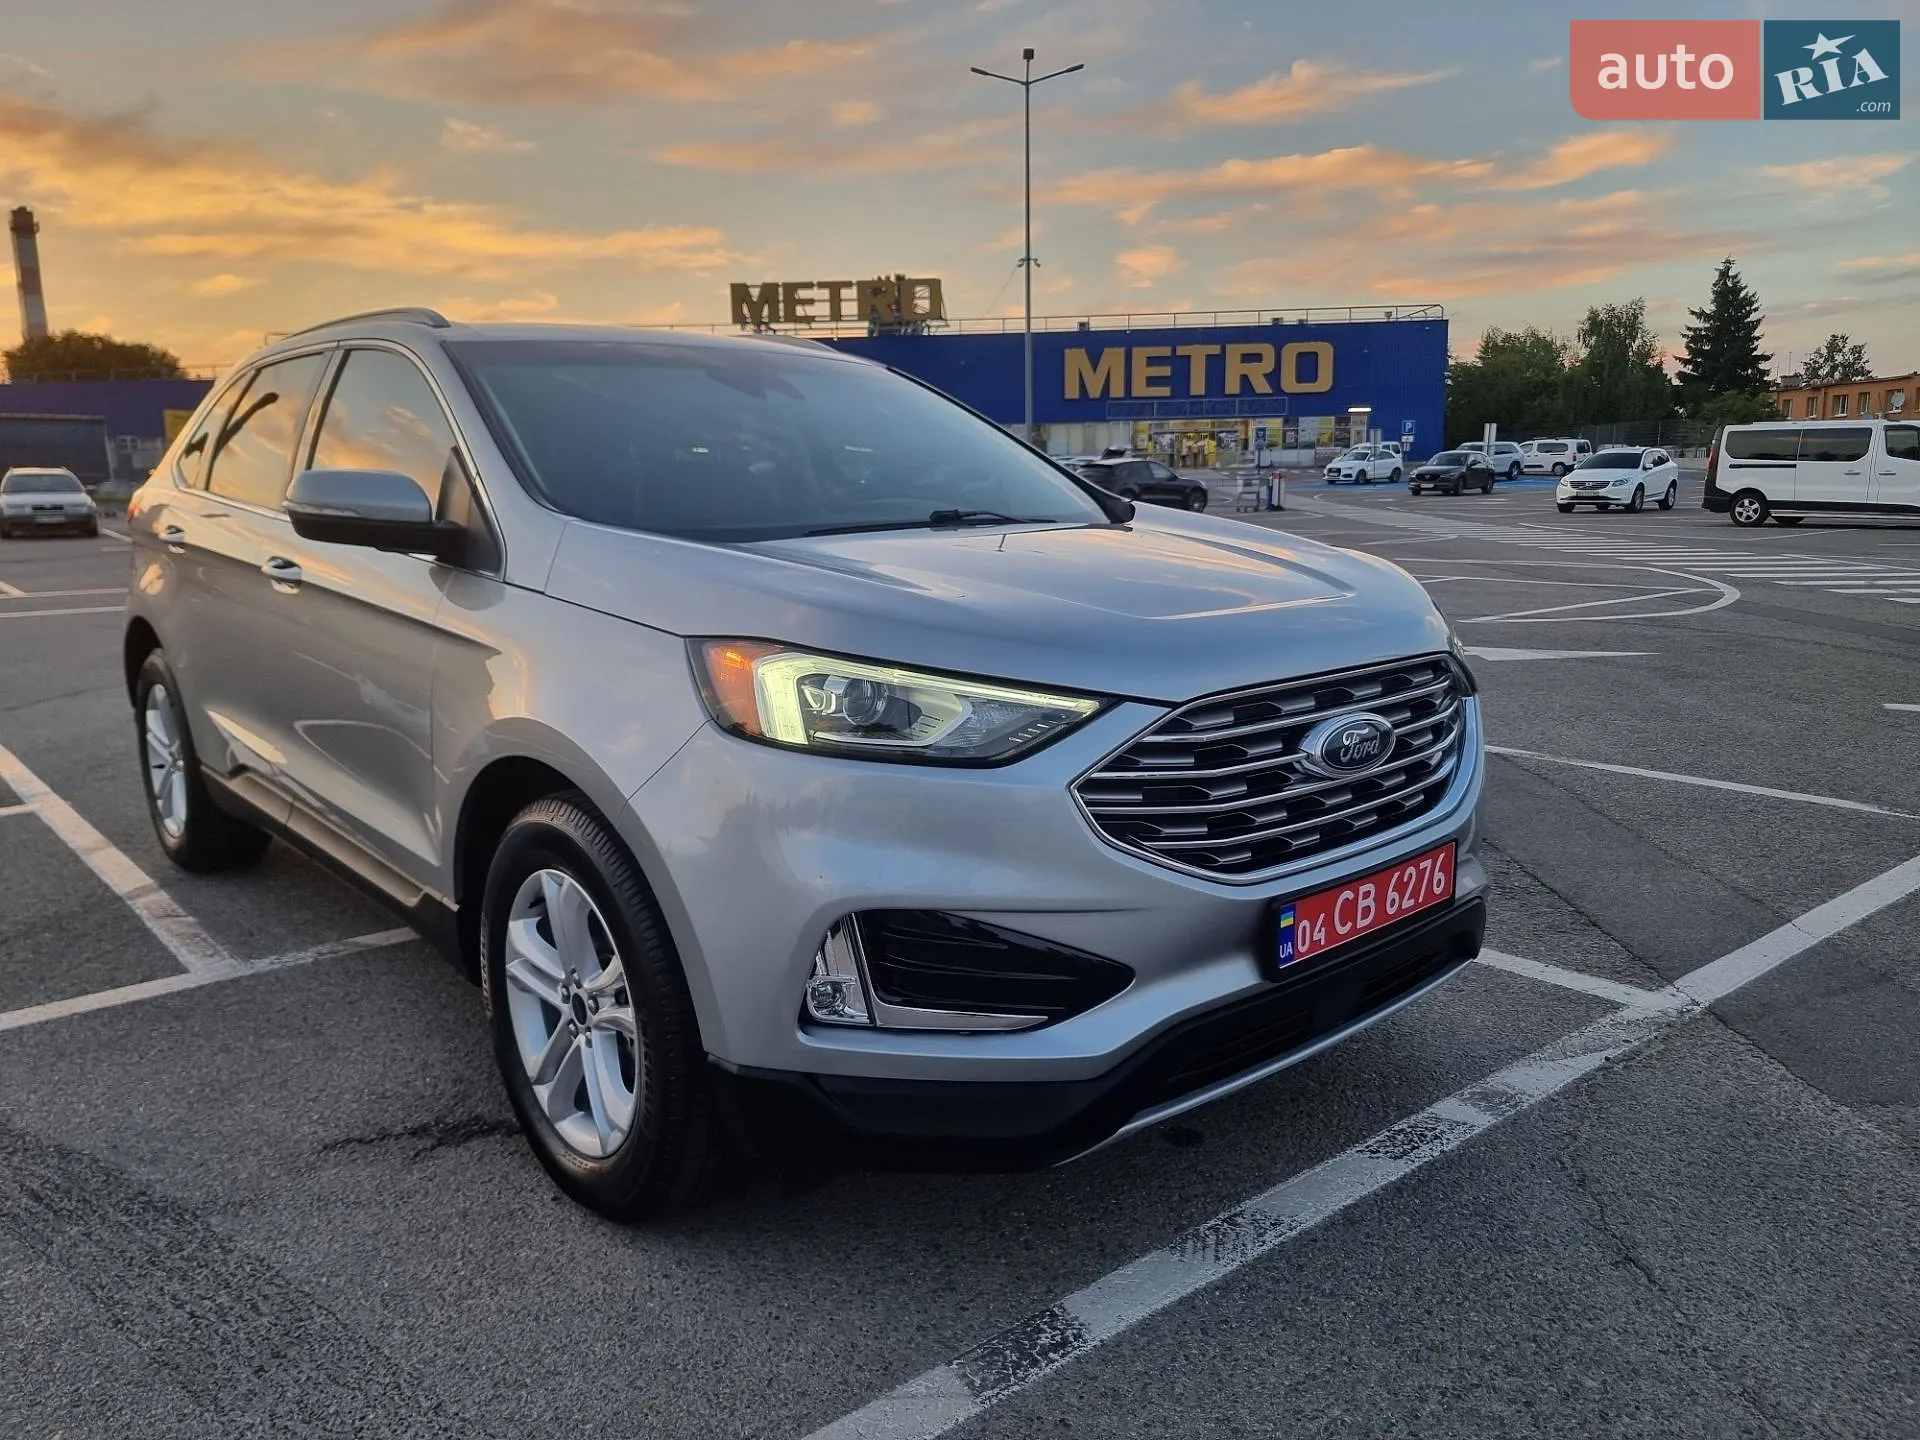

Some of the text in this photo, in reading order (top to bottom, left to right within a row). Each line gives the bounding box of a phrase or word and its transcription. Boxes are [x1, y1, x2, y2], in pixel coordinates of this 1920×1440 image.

[730, 278, 942, 324] METRO
[1064, 341, 1335, 399] METRO
[1340, 728, 1380, 763] Ford
[1297, 852, 1446, 953] 04 CB 6276
[1279, 941, 1294, 958] UA
